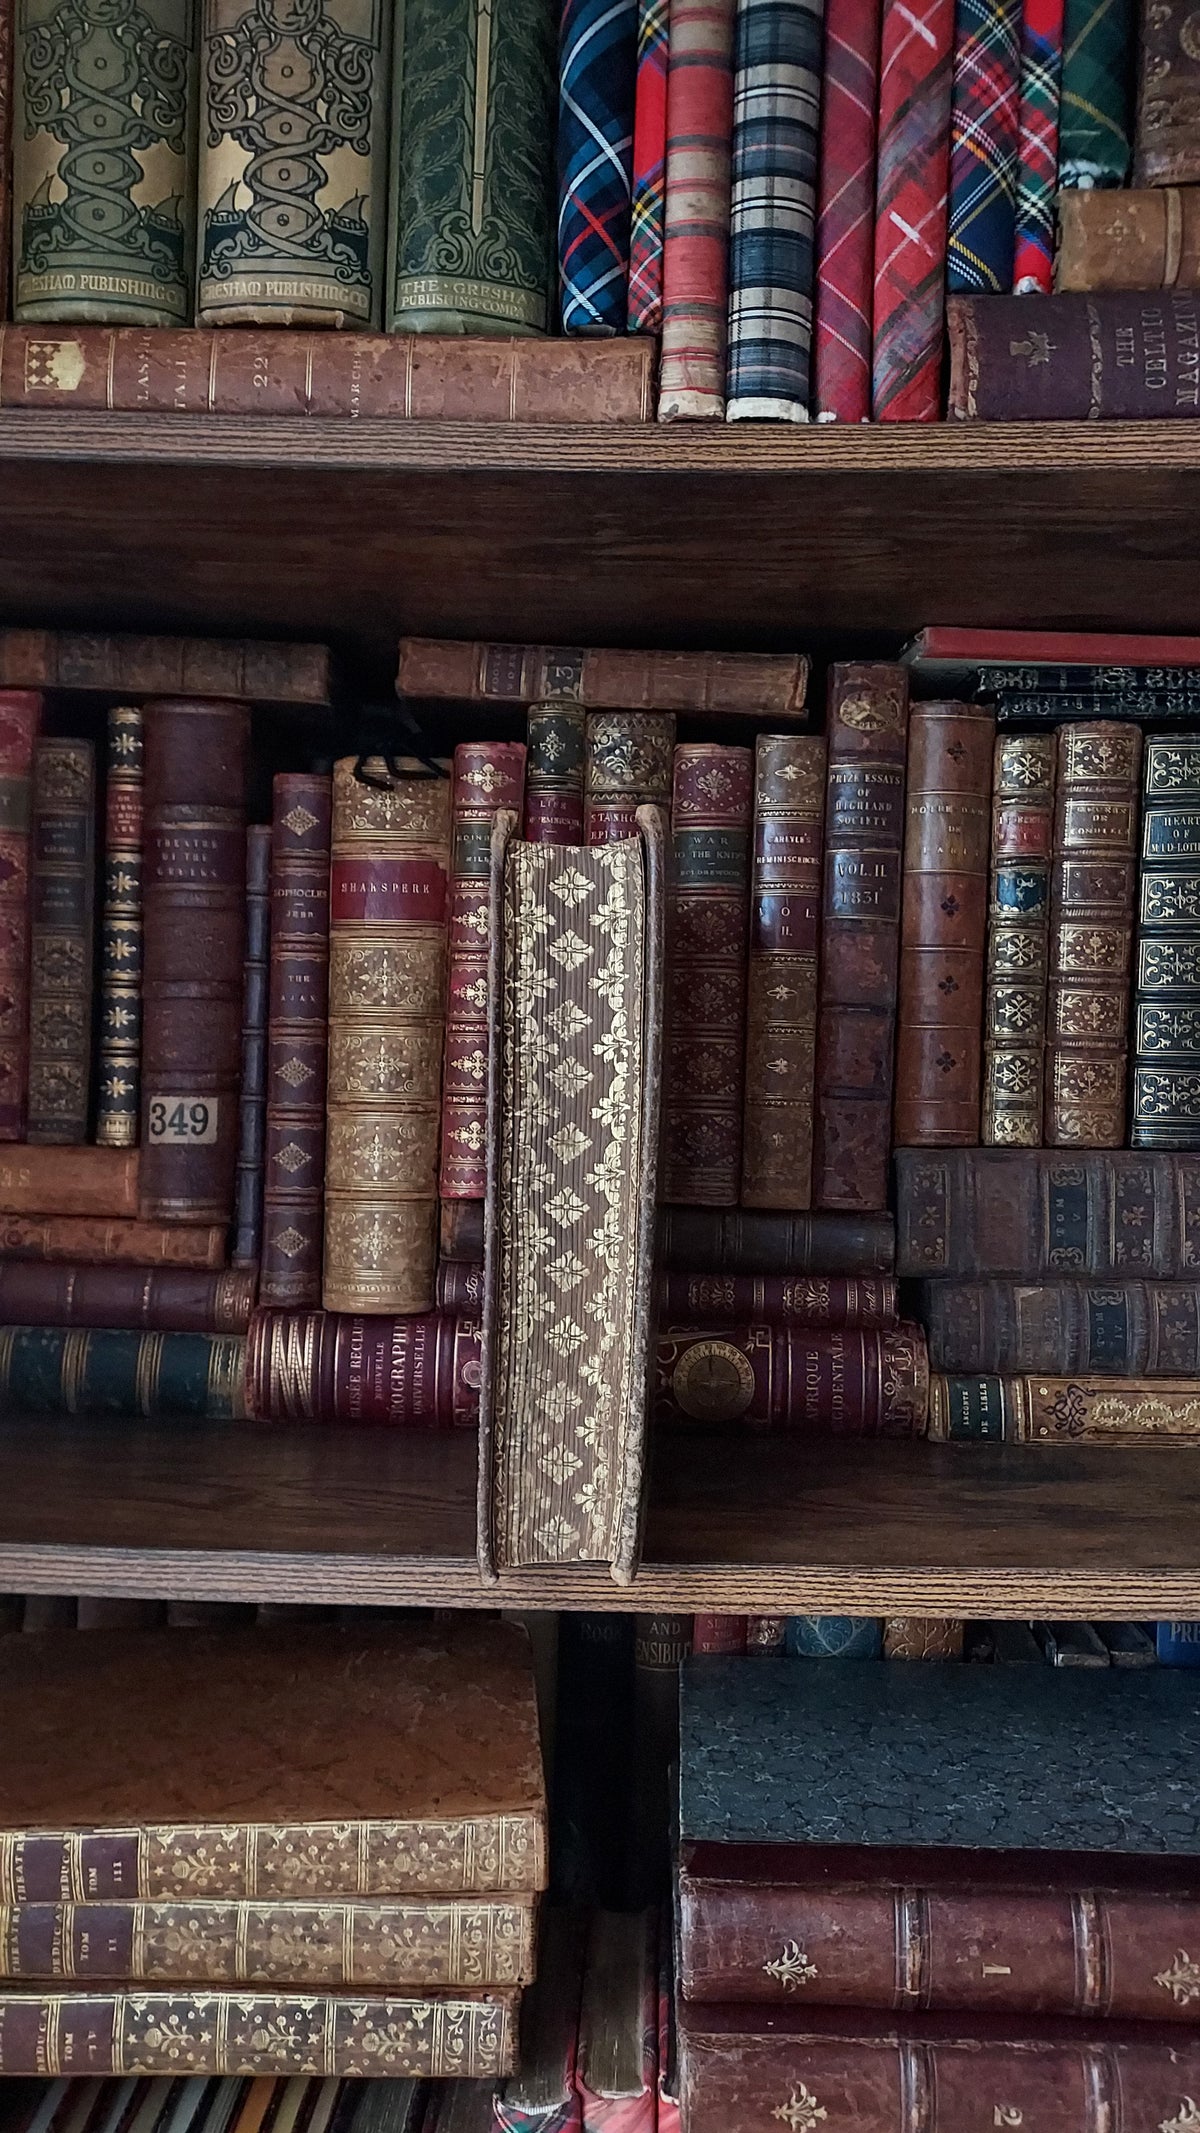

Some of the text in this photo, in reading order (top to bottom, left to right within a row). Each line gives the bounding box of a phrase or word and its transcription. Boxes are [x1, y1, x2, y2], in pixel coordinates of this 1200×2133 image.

[18, 274, 75, 294] ESHAM
[79, 274, 165, 299] PUBLISHING
[265, 281, 349, 303] PUBLISHING
[400, 279, 536, 305] THE GRESHA
[1115, 327, 1135, 367] THE
[1141, 307, 1167, 389] CELTIC
[253, 356, 270, 388] 22
[829, 774, 901, 785] PRIZE ESSAYS
[856, 788, 871, 797] OF
[590, 811, 638, 824] STANHO
[835, 801, 893, 812] HIGHLAND
[837, 815, 888, 827] SOCIETY
[1163, 815, 1200, 827] HEART
[692, 836, 729, 846] WAR
[1172, 828, 1190, 839] OF
[691, 850, 712, 859] THE
[341, 881, 431, 895] SHAKSPERE
[841, 890, 879, 905] 1831
[150, 1102, 209, 1136] 349
[374, 1341, 385, 1400] NOUVELLE
[386, 1317, 408, 1422] ÉOGRAPHI
[412, 1324, 426, 1415] UNIVERSELLE
[831, 1332, 844, 1430] CIDENTALE
[805, 1350, 821, 1418] AFRIQUE
[979, 1382, 989, 1433] DE LISLE
[650, 1621, 681, 1635] AND
[88, 1866, 98, 1893] TOM
[113, 1861, 122, 1882] III
[80, 1932, 90, 1961] TOM
[108, 1937, 118, 1952] II
[982, 1961, 1012, 1979] 1
[64, 2032, 74, 2062] TOM
[993, 2103, 1023, 2127] 2
